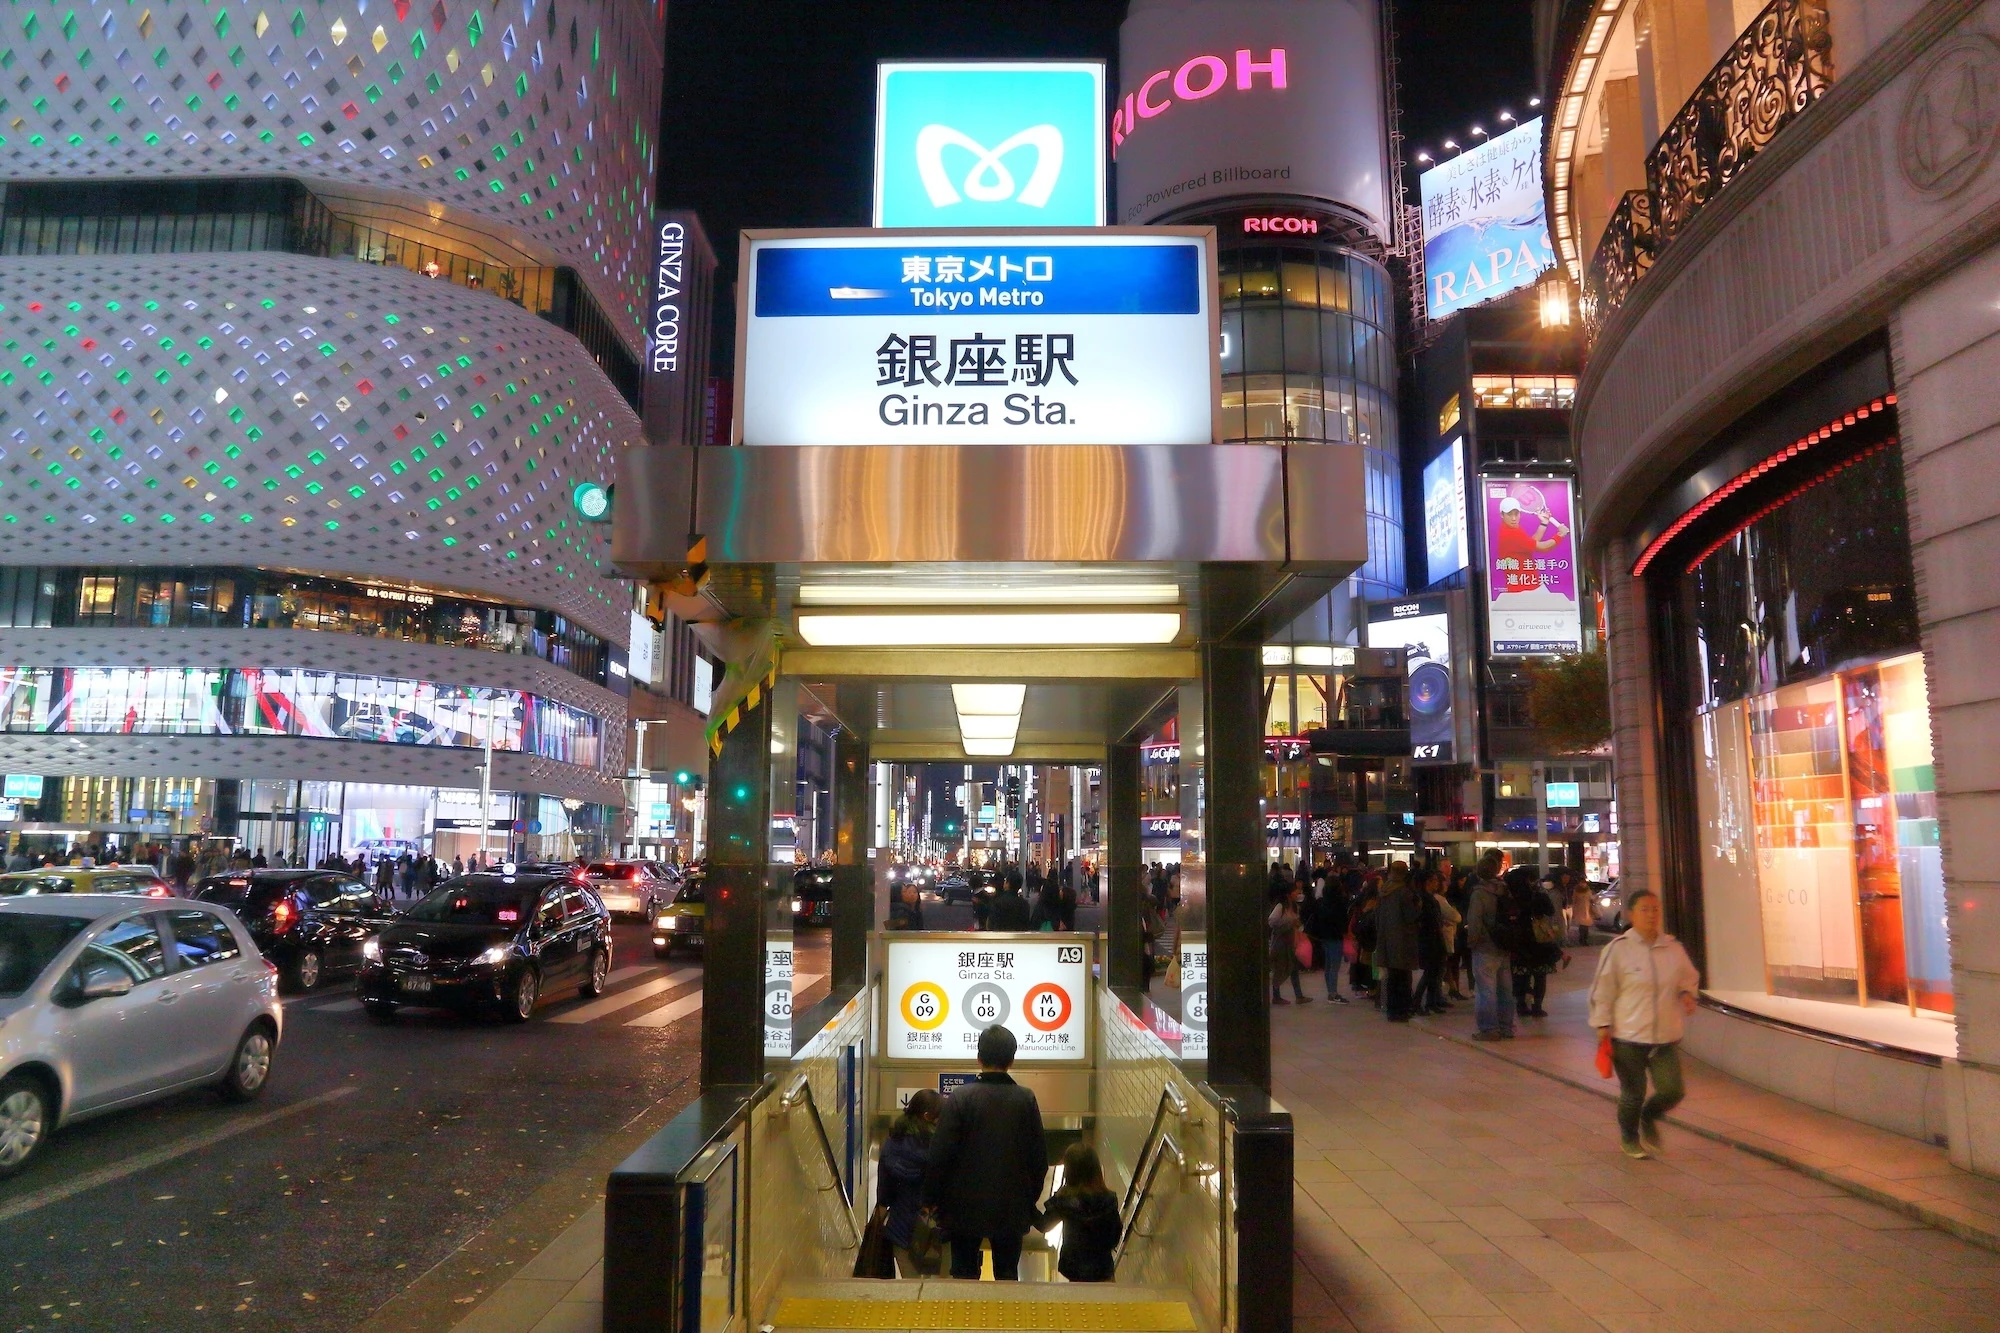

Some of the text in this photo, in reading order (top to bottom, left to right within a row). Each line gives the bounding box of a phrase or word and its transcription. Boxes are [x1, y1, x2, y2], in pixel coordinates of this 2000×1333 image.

[1112, 48, 1287, 162] RICOH
[1447, 132, 1532, 182] 美しさは健康から
[1127, 165, 1291, 221] Eco-Powered Billboard
[1244, 217, 1318, 233] RICOH
[901, 255, 1053, 284] 東京メトロ
[654, 222, 685, 373] GINZA CORE
[910, 287, 1045, 310] Tokyo Metro
[876, 332, 1079, 388] 銀座駅
[879, 393, 1076, 427] Ginza Sta.
[1523, 558, 1569, 571] 圭選手の
[1507, 574, 1560, 586] 進化と共に
[415, 595, 434, 605] CAFE
[1393, 604, 1419, 613] RICOH
[610, 660, 628, 678] SONY
[1414, 745, 1439, 758] K-1
[958, 952, 1014, 968] 銀座駅
[1059, 948, 1082, 963] A9
[959, 970, 1015, 980] Ginza Sta.
[920, 994, 930, 1004] G
[981, 994, 990, 1004] H
[1041, 995, 1053, 1004] M
[916, 1006, 934, 1017] 09
[977, 1006, 995, 1017] 08
[1040, 1006, 1056, 1018] 16
[907, 1032, 943, 1043] 銀座線
[963, 1033, 980, 1043] 日比
[1025, 1033, 1070, 1043] 丸ノ内線
